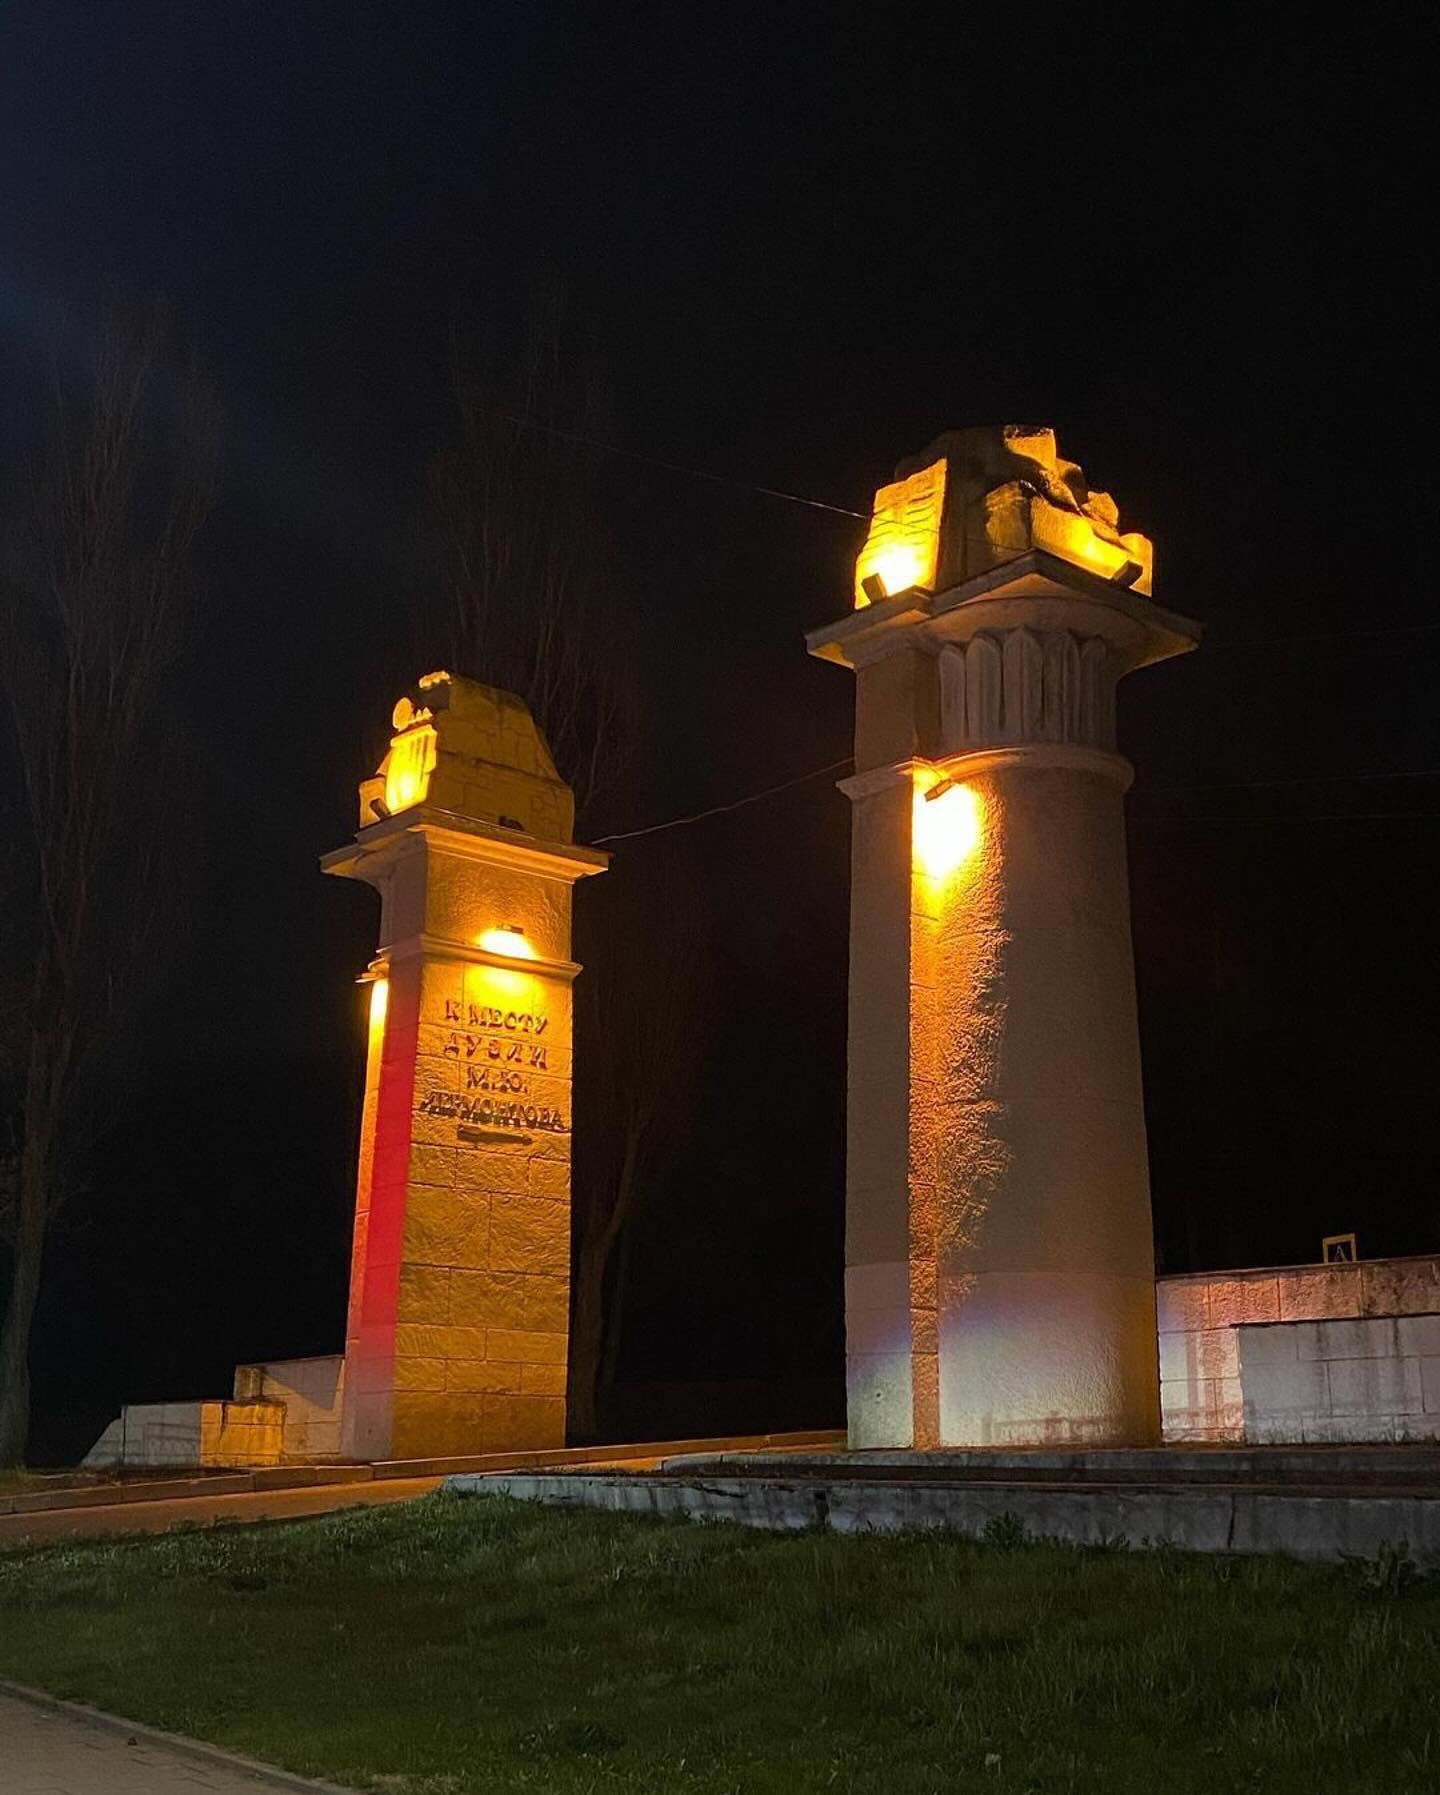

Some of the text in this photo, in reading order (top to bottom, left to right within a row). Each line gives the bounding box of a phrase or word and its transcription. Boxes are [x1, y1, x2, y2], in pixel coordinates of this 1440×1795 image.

[445, 999, 548, 1035] К МЕСТУ
[444, 1032, 547, 1070] ДУЭЛИ
